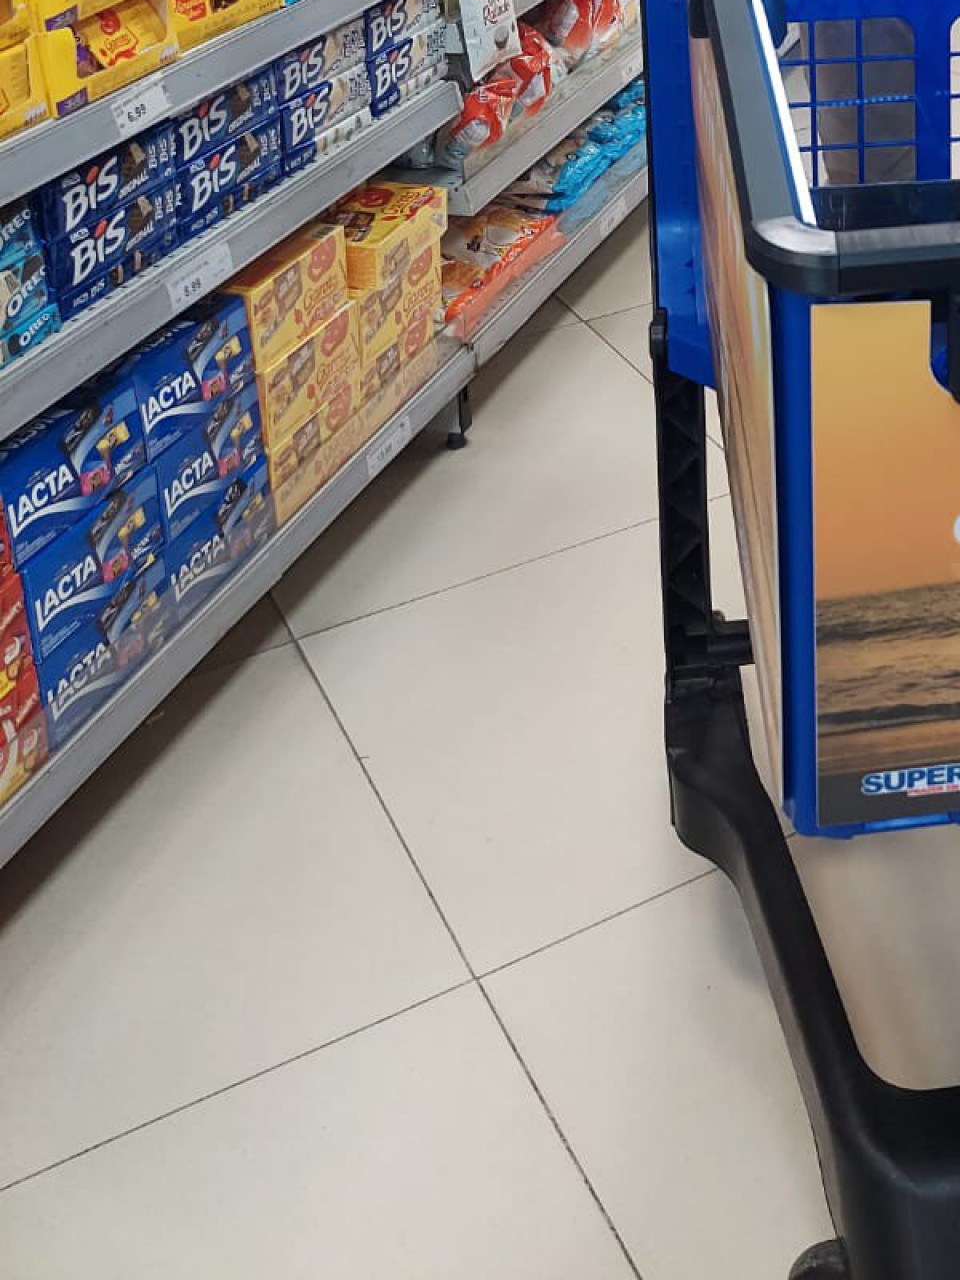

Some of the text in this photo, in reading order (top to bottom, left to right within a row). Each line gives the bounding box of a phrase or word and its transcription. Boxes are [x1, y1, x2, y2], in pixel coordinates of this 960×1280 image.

[141, 370, 197, 434] LACTA
[8, 463, 75, 538] LACTA
[164, 450, 214, 519] LACTA
[35, 554, 97, 632] LACTA
